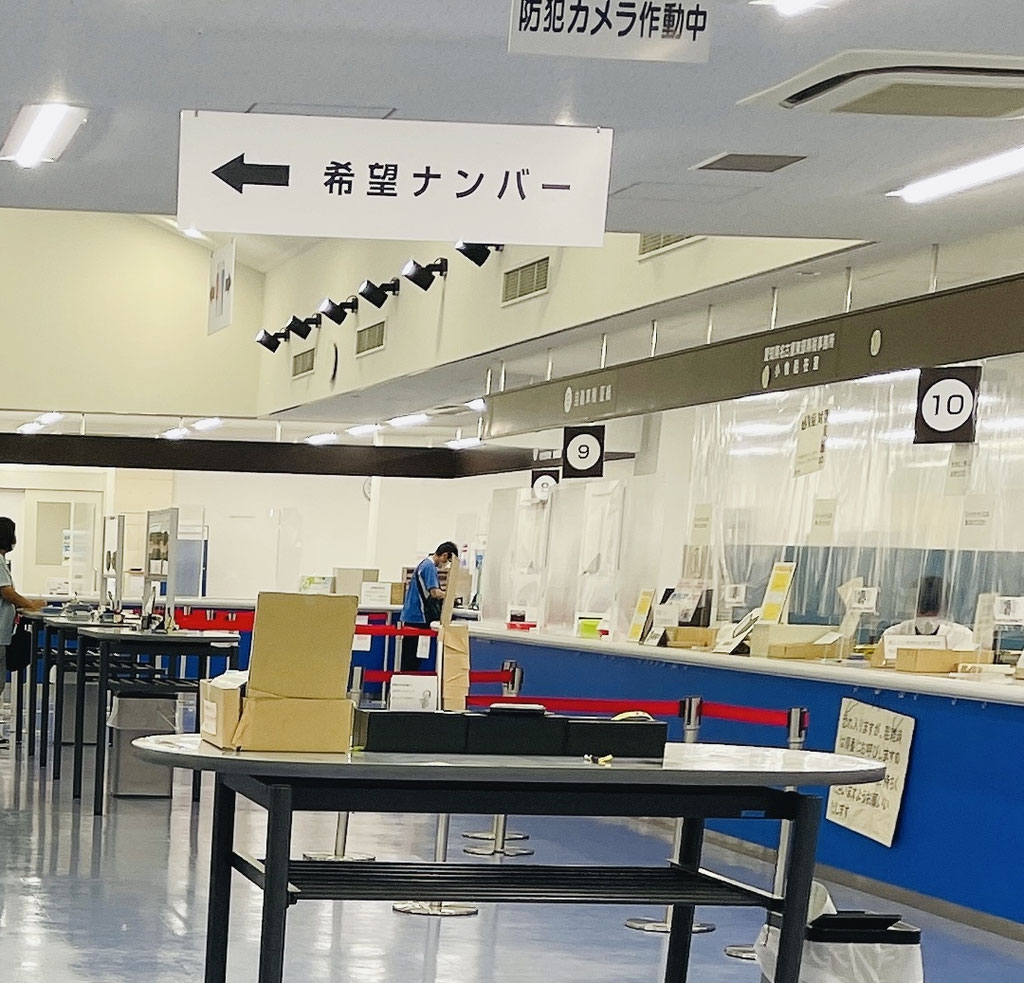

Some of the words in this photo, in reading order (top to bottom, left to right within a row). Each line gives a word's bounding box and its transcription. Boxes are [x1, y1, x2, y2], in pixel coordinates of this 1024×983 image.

[519, 0, 707, 41] 防犯カメラ作動中
[323, 160, 571, 201] 希望ナンバー
[932, 394, 965, 416] 10
[577, 444, 590, 459] 9
